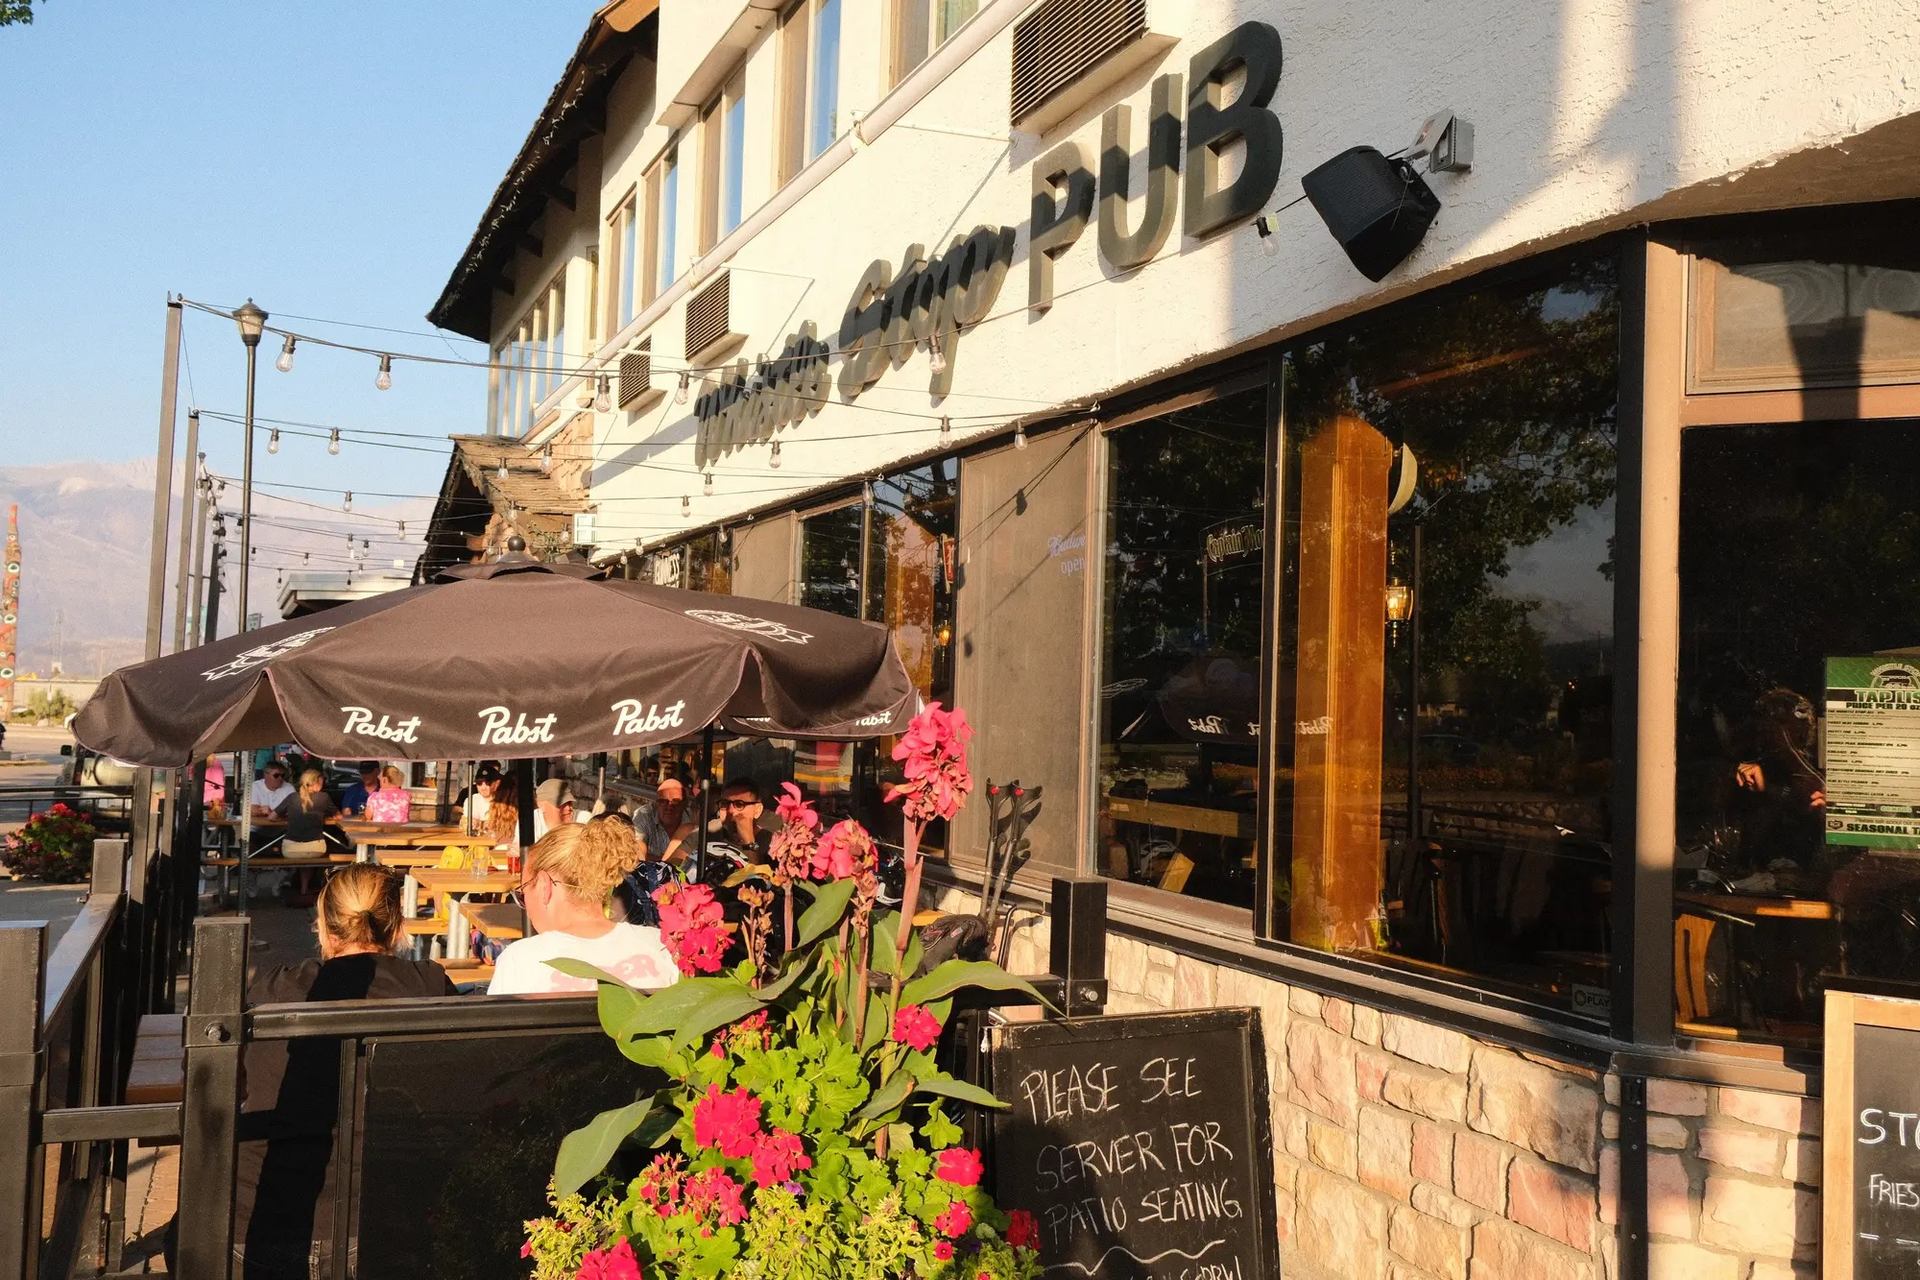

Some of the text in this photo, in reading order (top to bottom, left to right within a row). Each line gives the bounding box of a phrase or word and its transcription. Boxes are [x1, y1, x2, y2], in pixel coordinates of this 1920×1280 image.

[838, 225, 1016, 400] Stop
[1029, 21, 1283, 312] PUB
[1854, 690, 1893, 702] TAP
[340, 706, 421, 744] Pabst
[479, 706, 557, 745] Pabst
[611, 699, 684, 736] Pabst
[1847, 823, 1908, 835] SEASONAL
[1020, 1058, 1202, 1125] PLEASE SEE
[1858, 1108, 1920, 1150] ST
[1036, 1121, 1233, 1192] SERVER FOR
[1869, 1173, 1920, 1207] FRIES
[1045, 1178, 1243, 1246] PATIO SEATING
